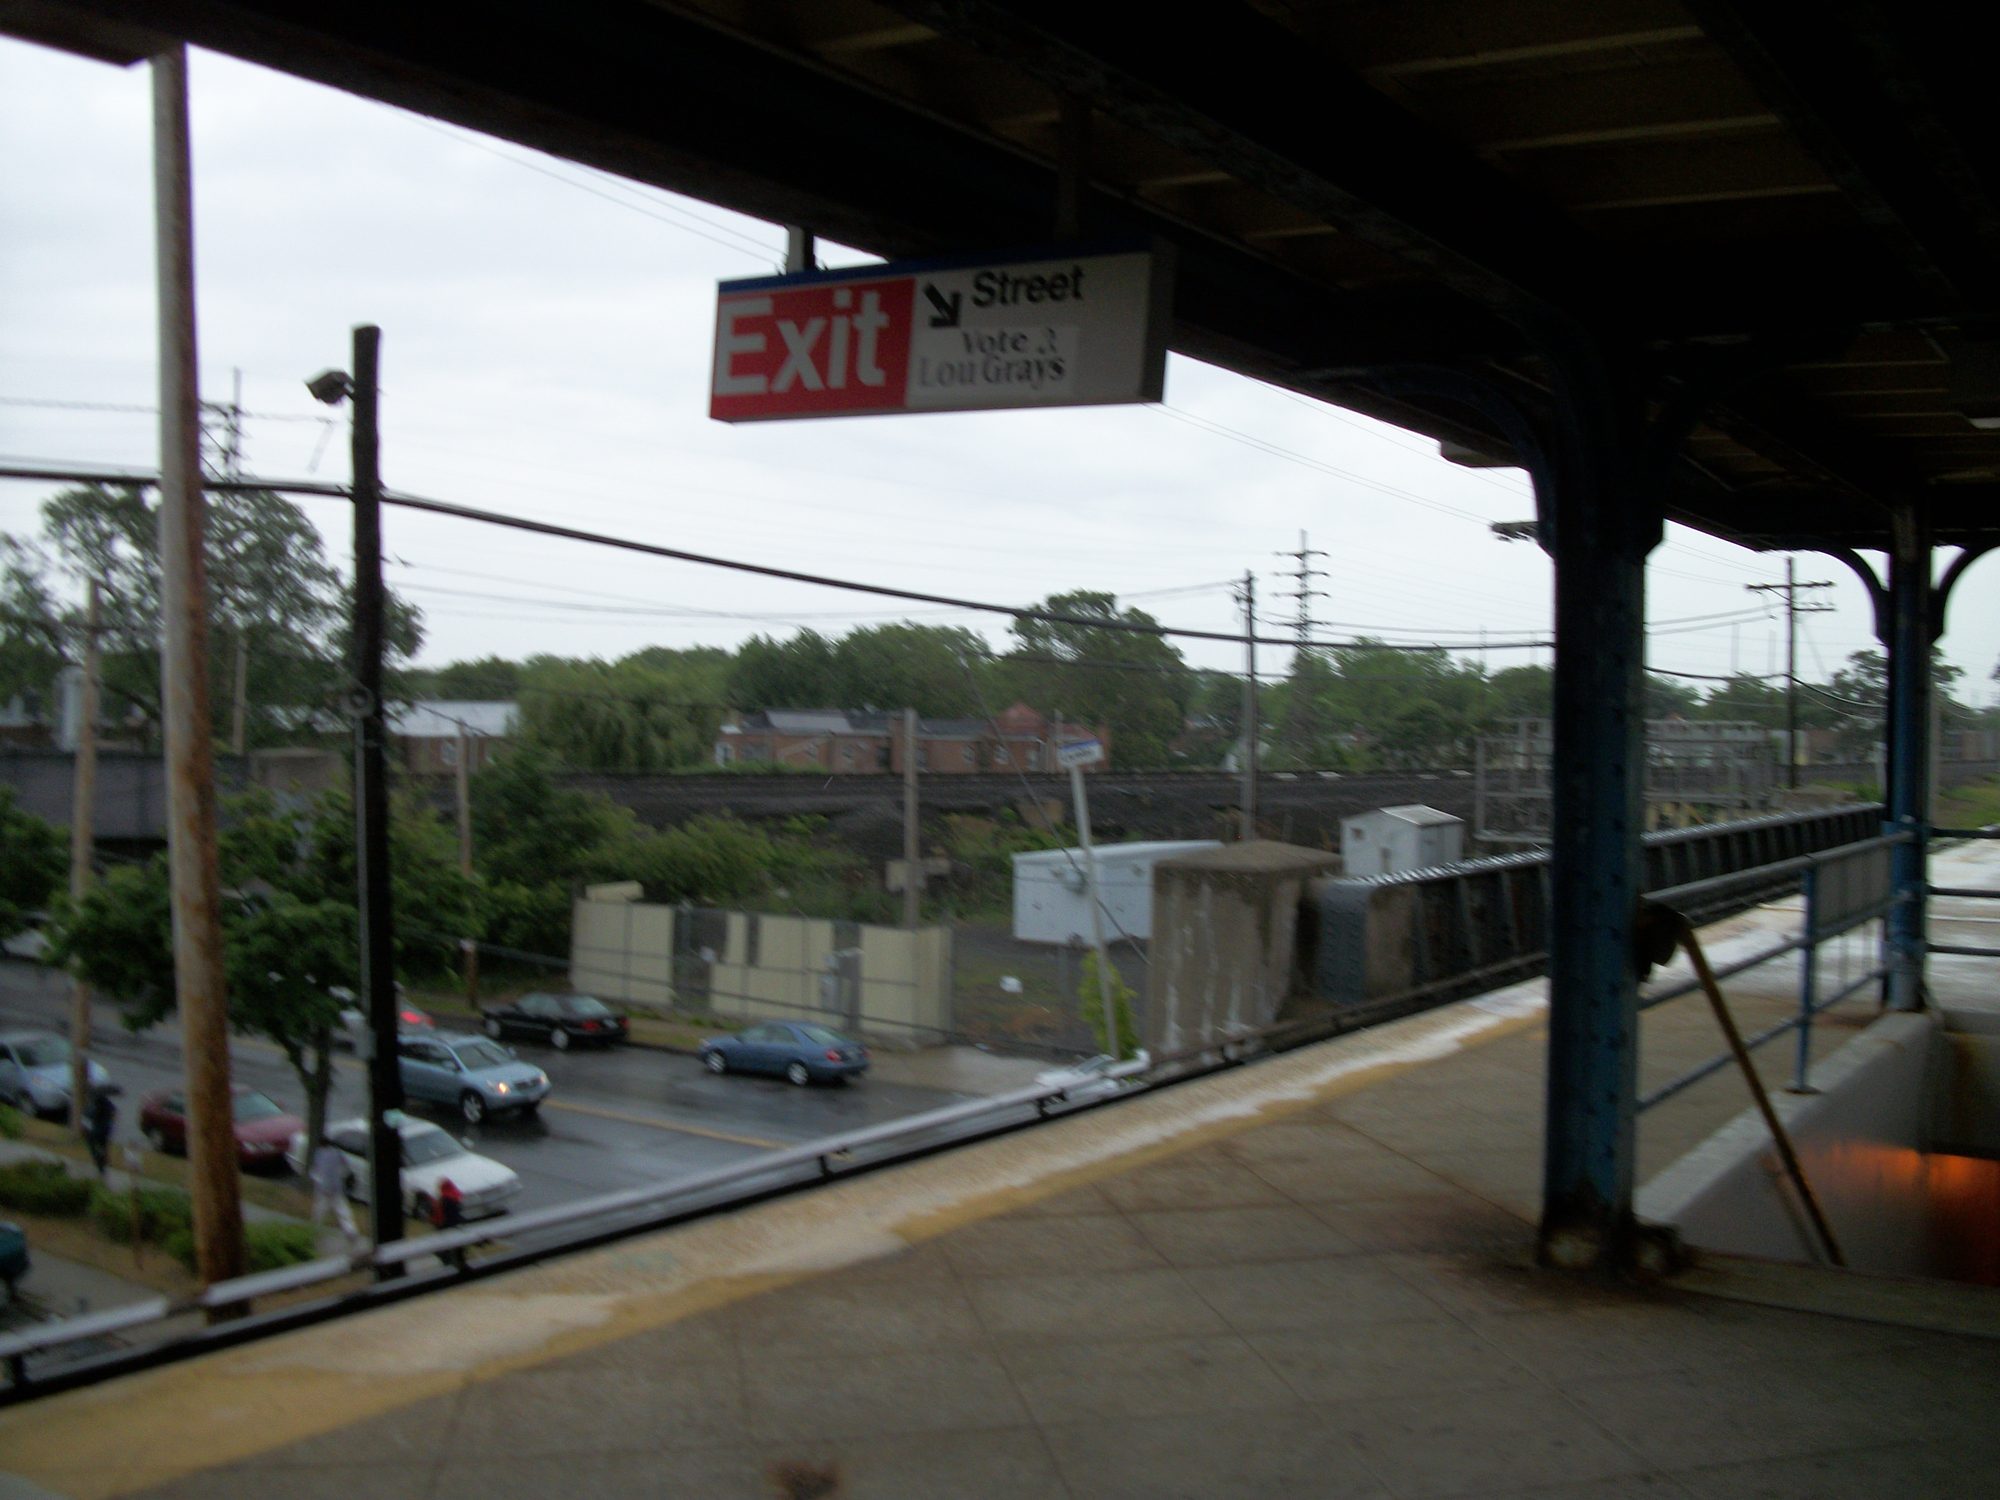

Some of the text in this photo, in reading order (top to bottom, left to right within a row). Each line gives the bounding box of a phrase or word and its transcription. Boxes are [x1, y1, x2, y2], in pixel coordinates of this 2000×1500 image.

[971, 266, 1084, 308] Street
[713, 290, 889, 394] Exit
[961, 328, 1029, 355] Vote
